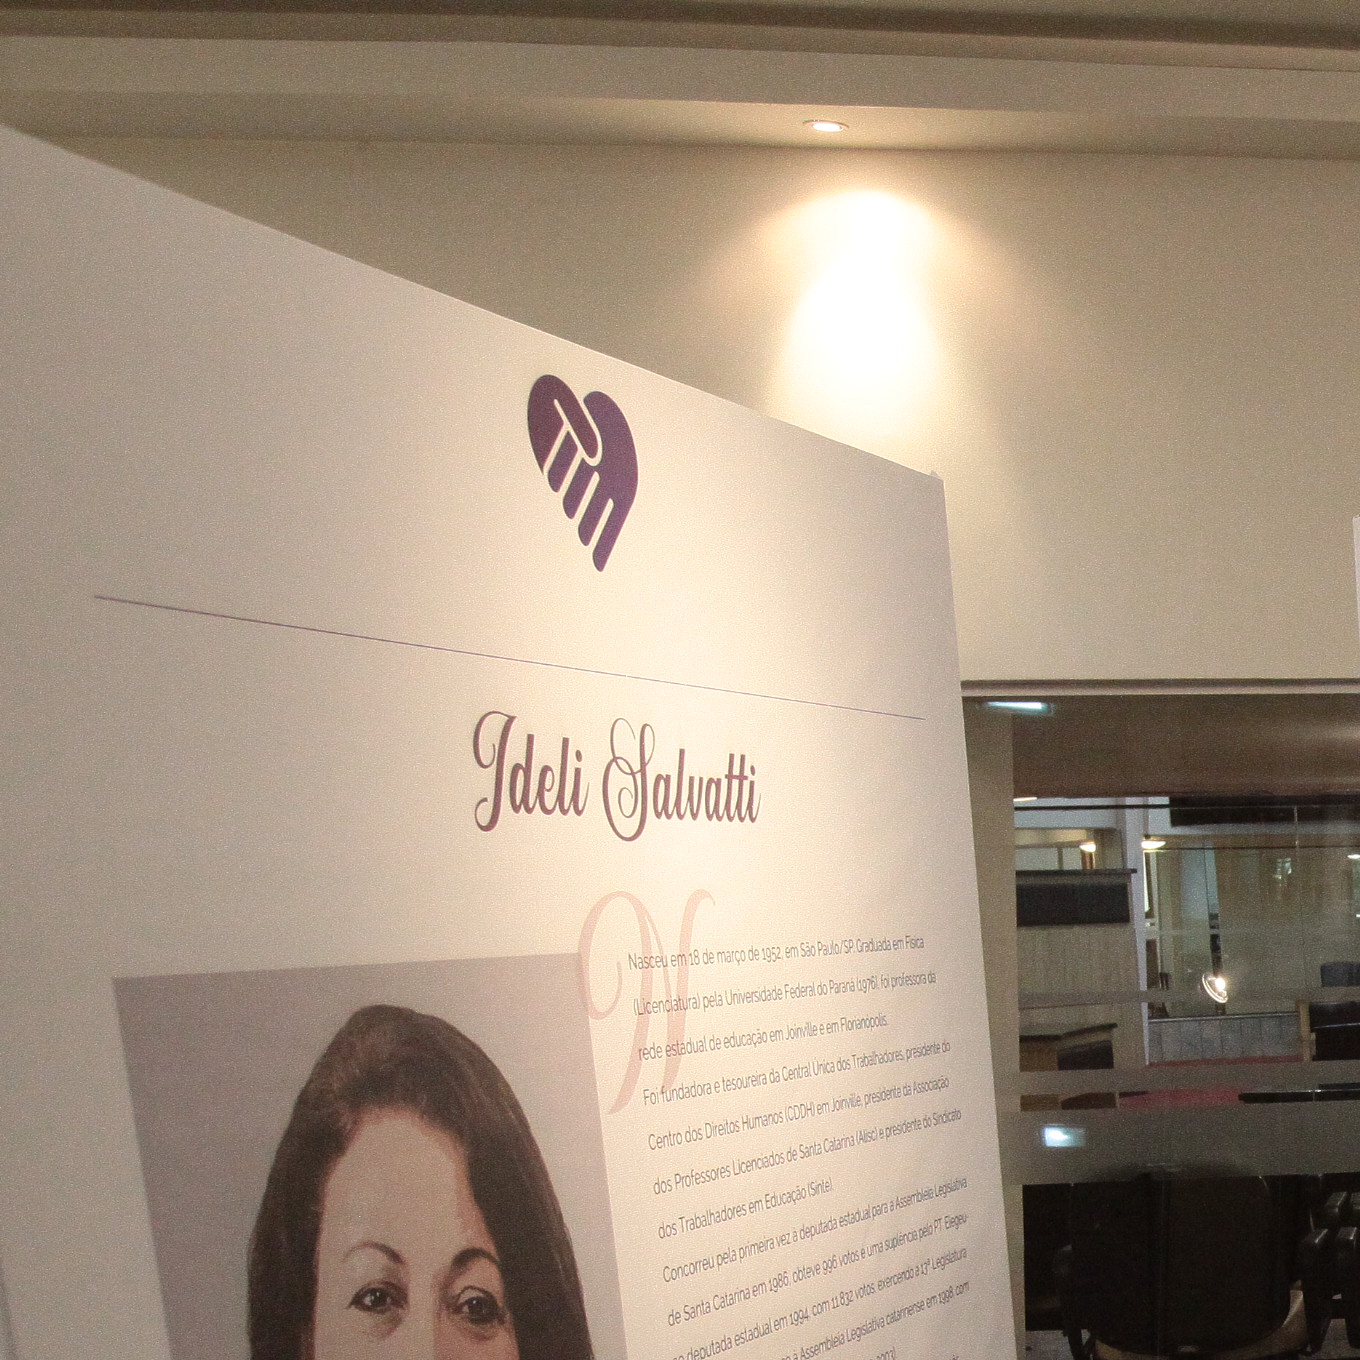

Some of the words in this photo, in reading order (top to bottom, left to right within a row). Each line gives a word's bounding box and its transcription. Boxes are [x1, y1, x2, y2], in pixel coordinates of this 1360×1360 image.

[473, 711, 590, 832] Ideli
[602, 718, 762, 842] Salvatti
[637, 1045, 662, 1062] rede
[664, 1036, 707, 1058] estadual
[708, 1035, 721, 1051] de
[723, 1028, 767, 1049] educação
[769, 1029, 782, 1042] em
[819, 1023, 824, 1035] e
[826, 1021, 838, 1034] em
[658, 1222, 677, 1239] dos
[678, 1203, 746, 1232] Trabalhadores
[748, 1198, 763, 1214] em
[764, 1185, 806, 1210] Educação
